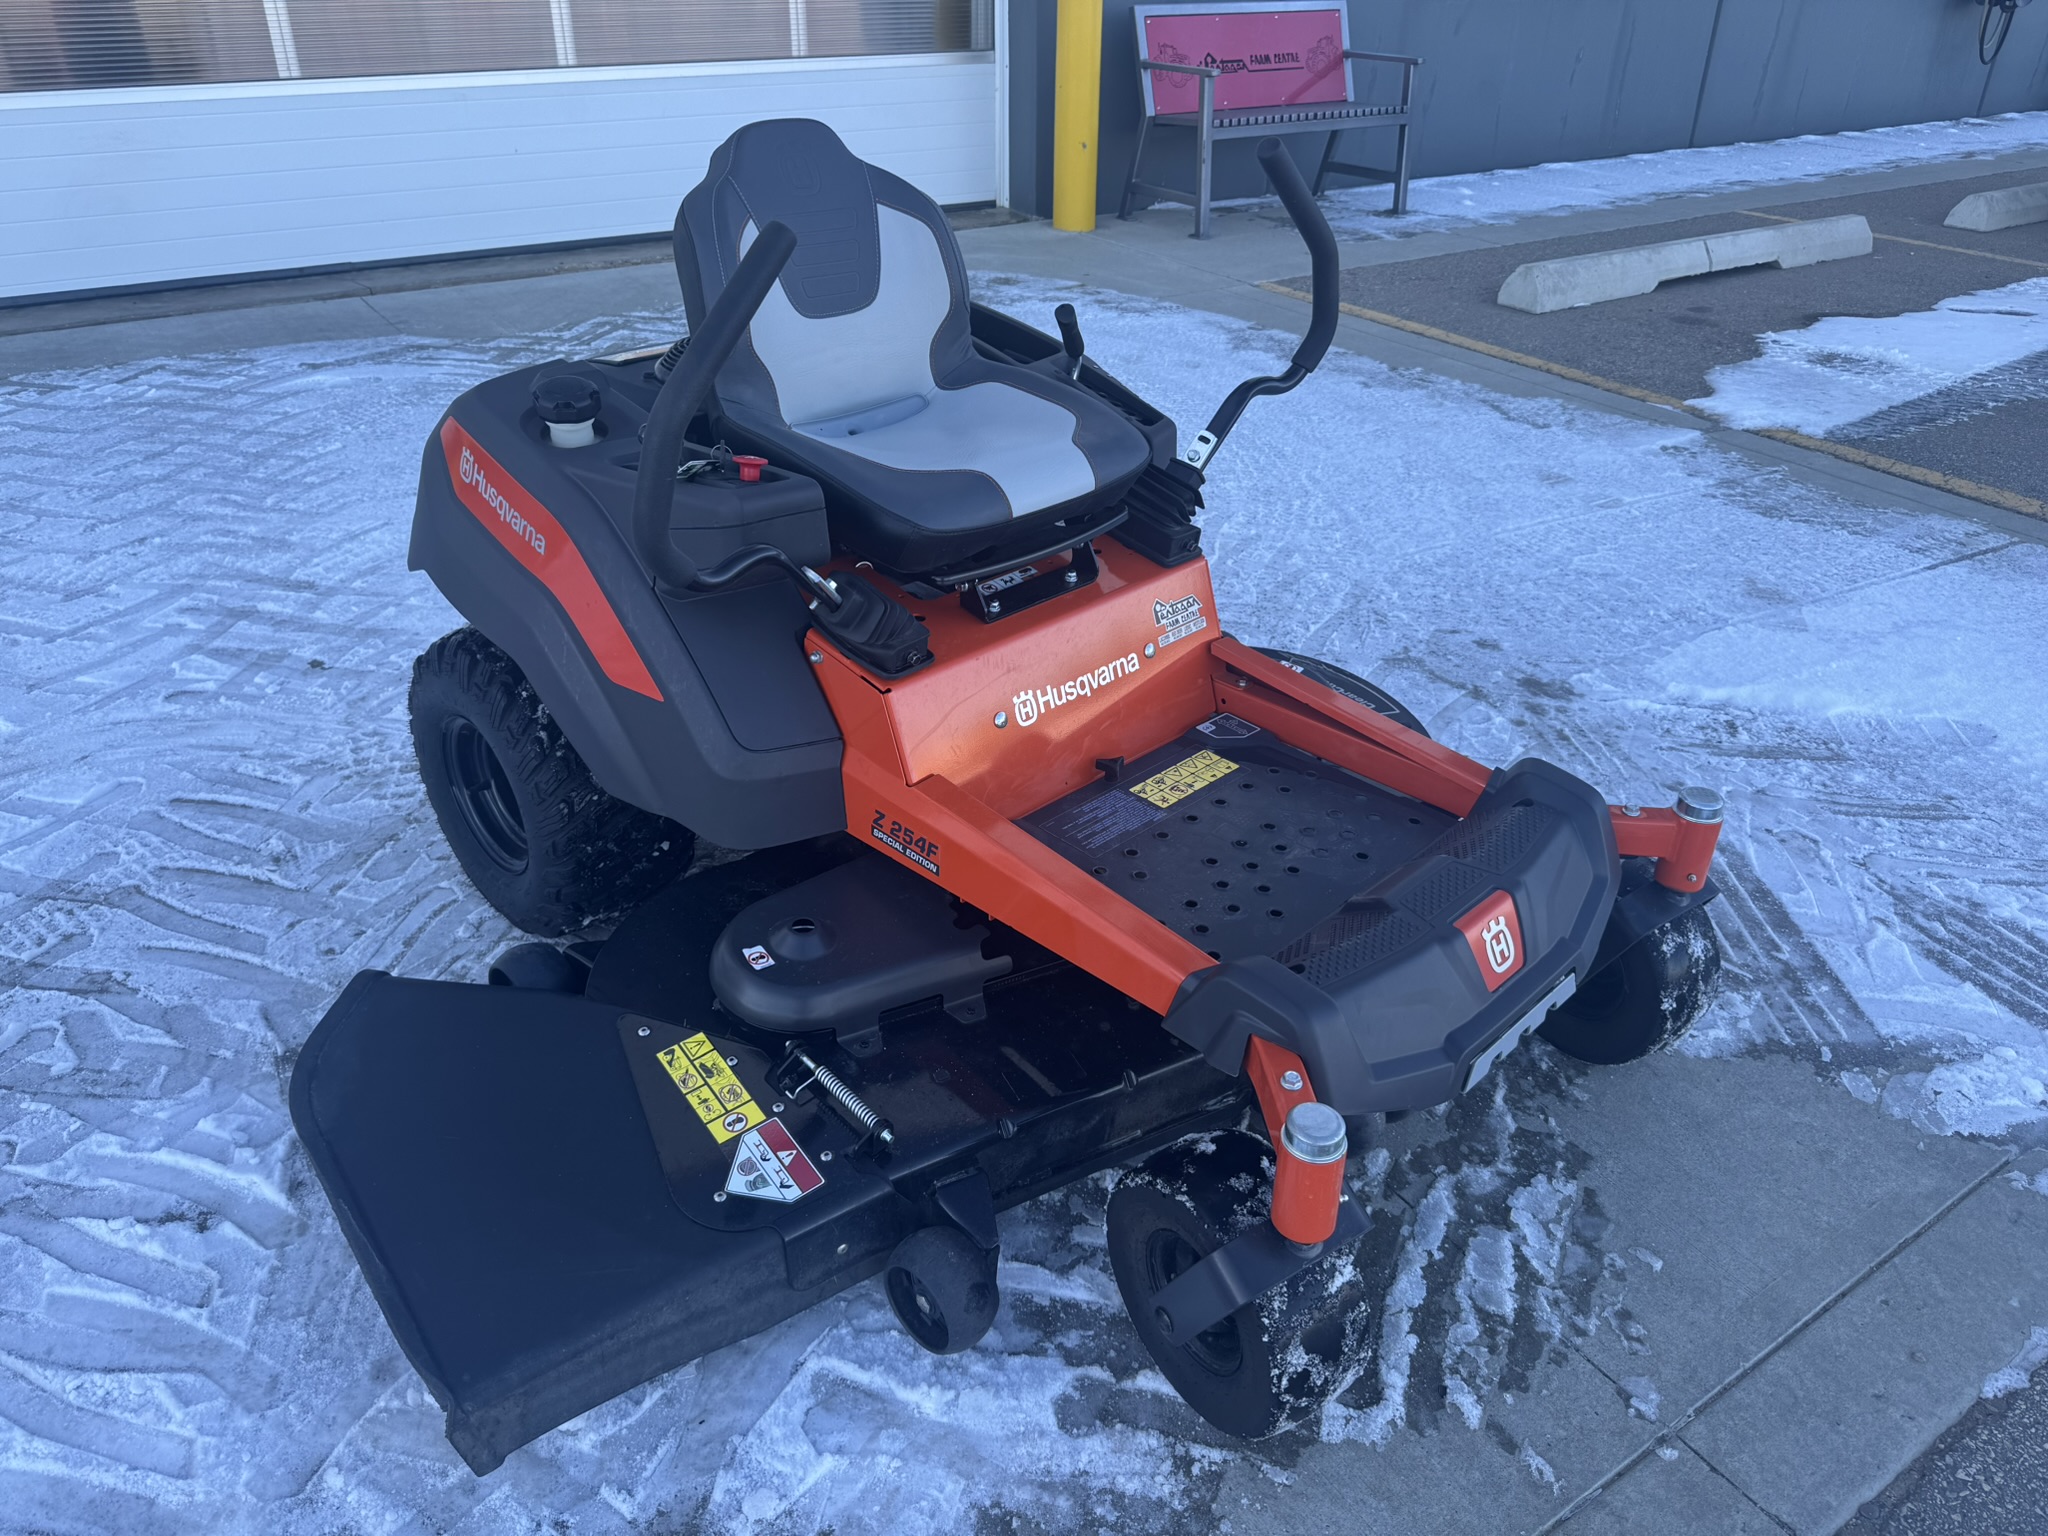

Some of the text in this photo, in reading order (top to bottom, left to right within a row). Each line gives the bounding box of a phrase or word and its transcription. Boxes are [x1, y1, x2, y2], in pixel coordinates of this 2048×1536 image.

[1249, 54, 1271, 65] FARM
[1273, 52, 1300, 64] CENTRE
[472, 463, 546, 555] Husqvarna
[1165, 617, 1181, 630] FARM
[1036, 652, 1140, 714] Husqvarna
[872, 809, 939, 858] Z 254F
[872, 828, 938, 873] SPECIAL EDITION
